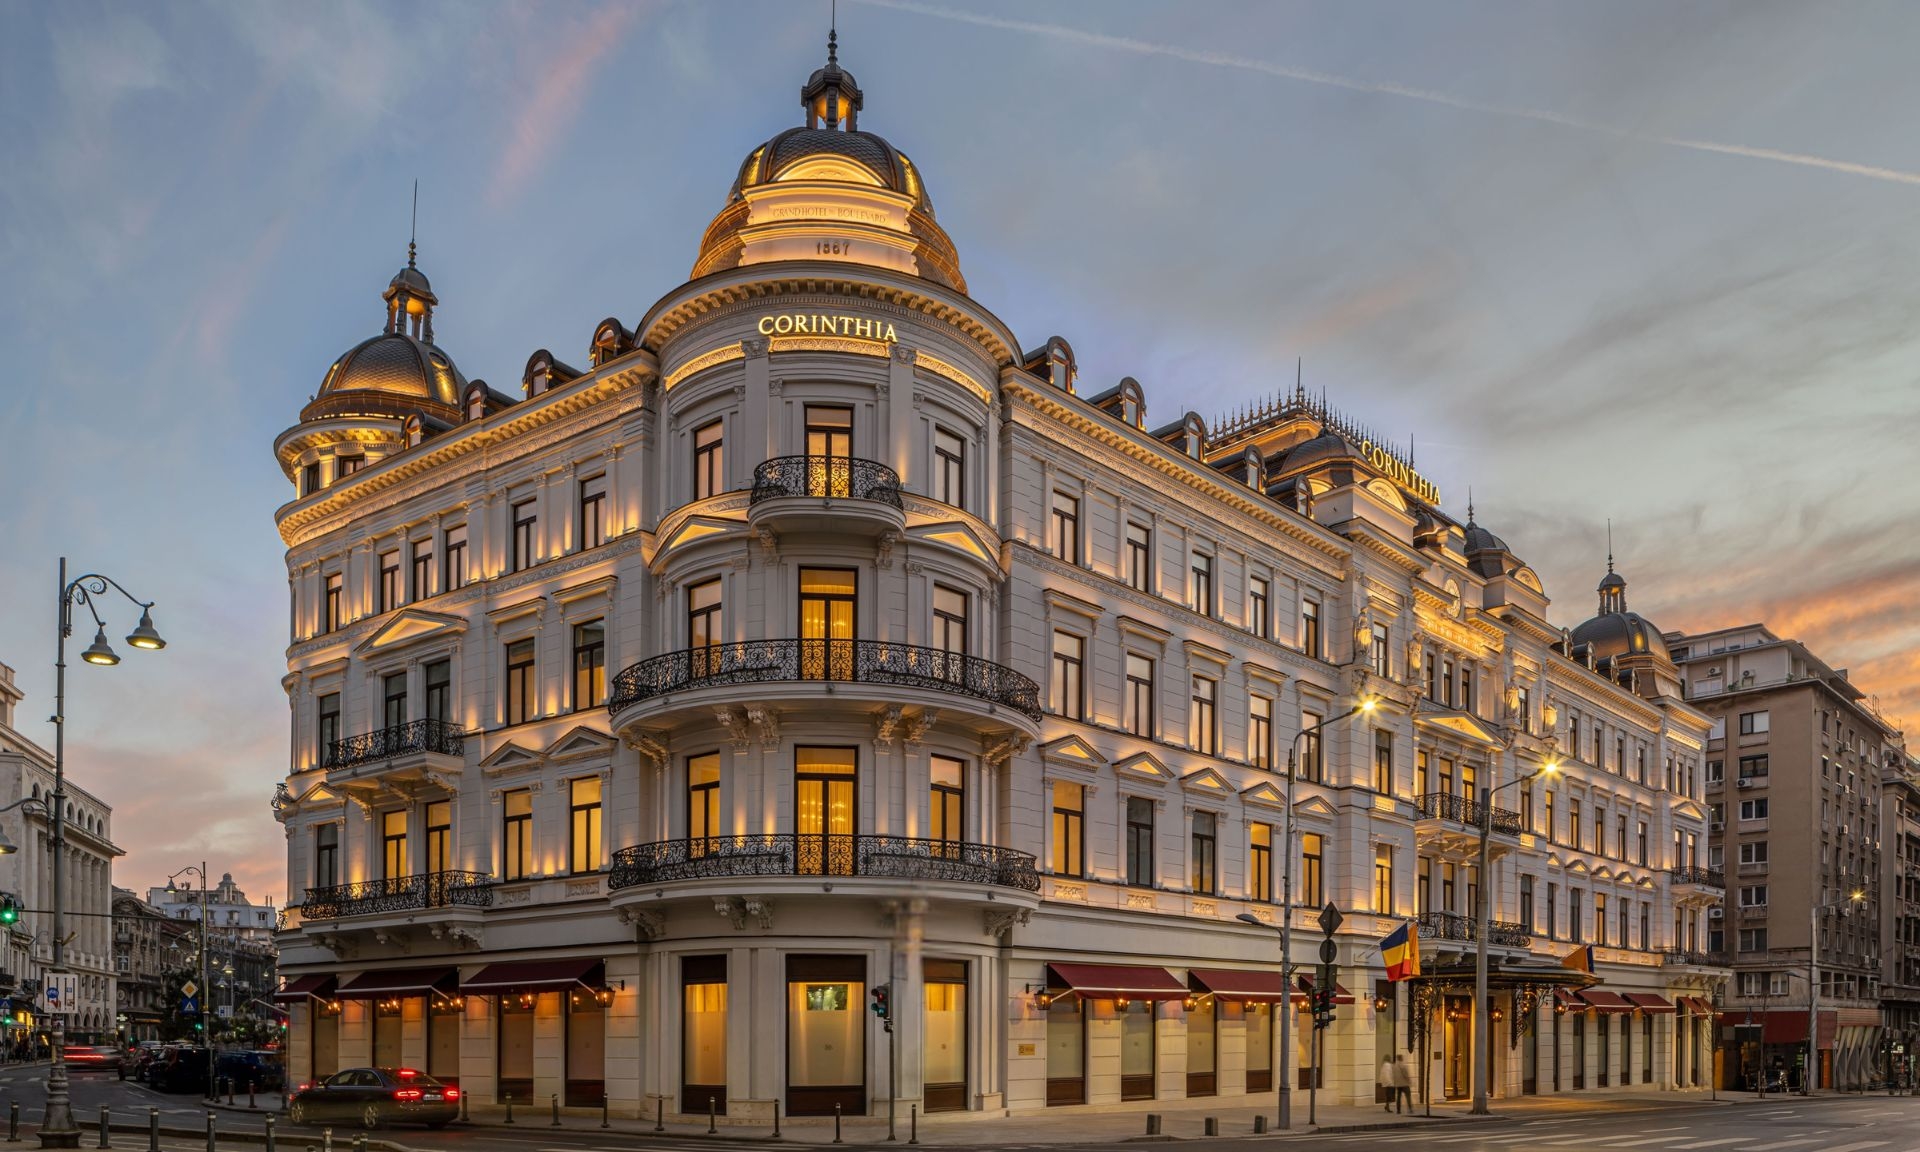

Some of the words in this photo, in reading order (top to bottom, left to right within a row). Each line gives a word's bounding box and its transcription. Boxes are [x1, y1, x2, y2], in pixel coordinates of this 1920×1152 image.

[773, 208, 801, 217] GRAND
[801, 207, 829, 217] HOTEL
[837, 208, 886, 223] BOULEVARD
[816, 241, 850, 256] 1867
[758, 315, 898, 343] CORINTHIA
[1362, 440, 1442, 505] CORINTHIA
